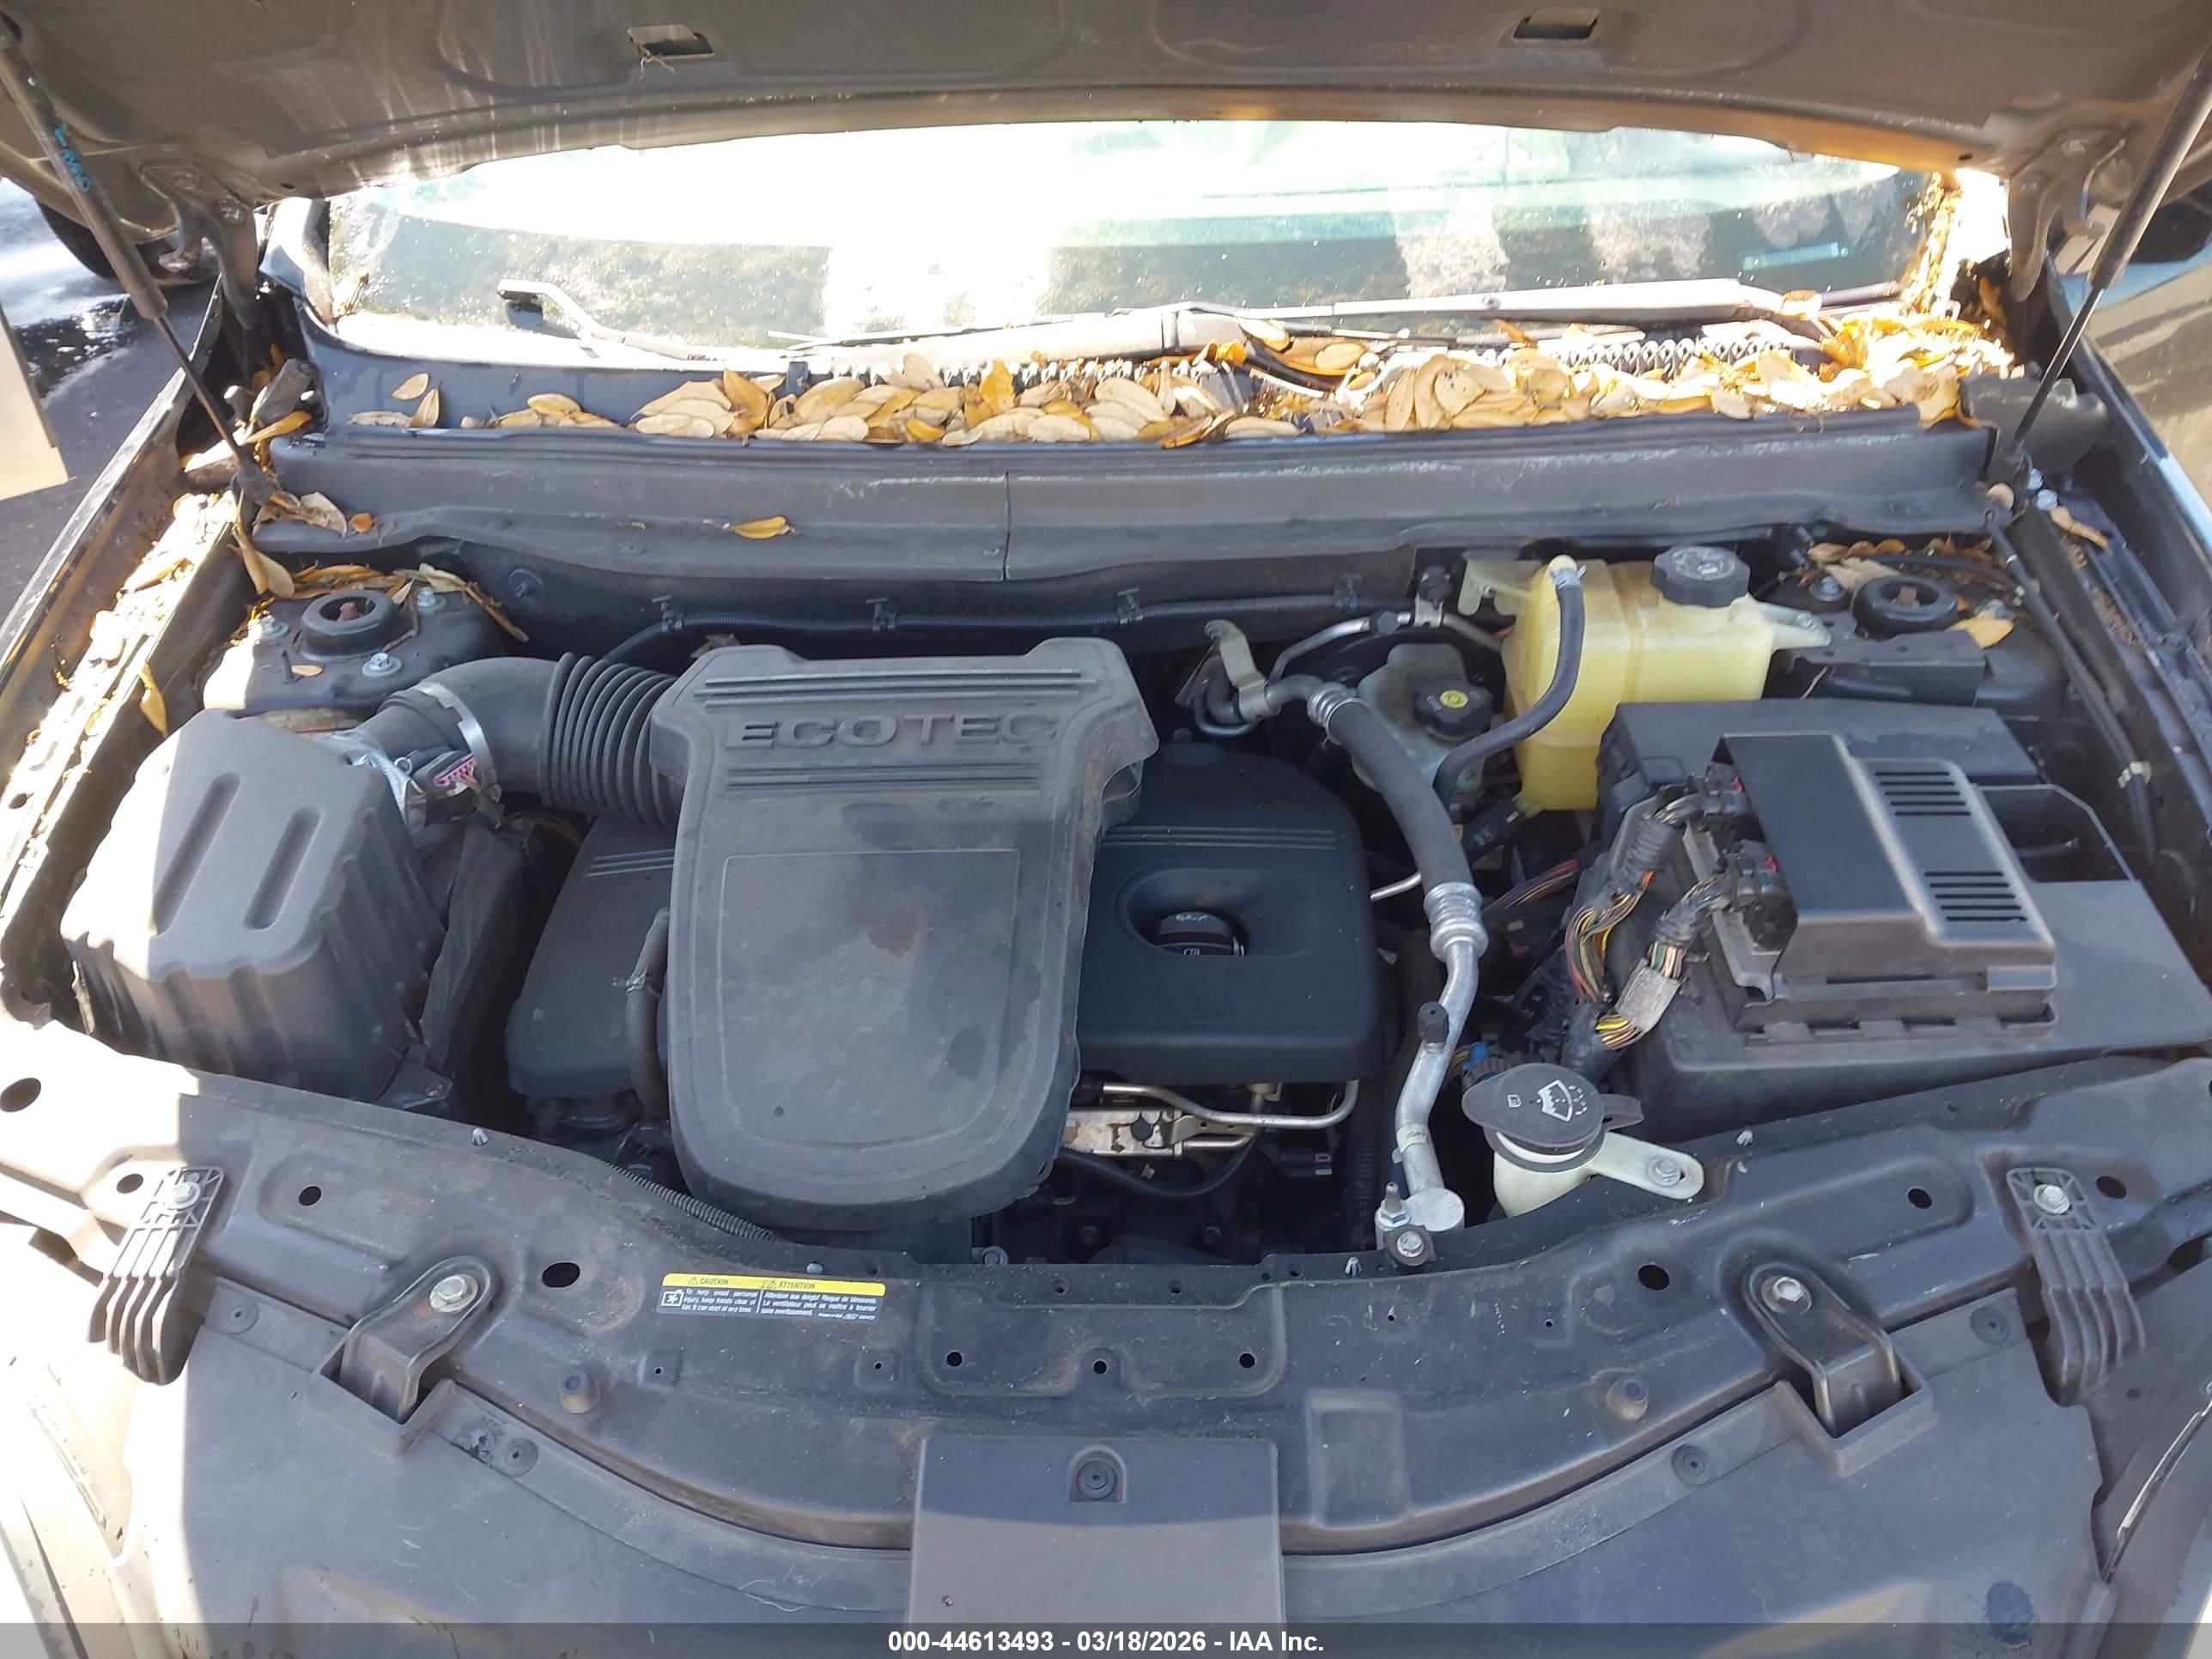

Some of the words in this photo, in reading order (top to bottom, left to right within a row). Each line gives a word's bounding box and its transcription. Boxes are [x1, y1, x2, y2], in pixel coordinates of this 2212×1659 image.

[728, 712, 1059, 750] ECOTEC
[699, 1277, 728, 1285] CAUTION
[778, 1280, 815, 1290] ATTENTION
[763, 1291, 788, 1299] Attention
